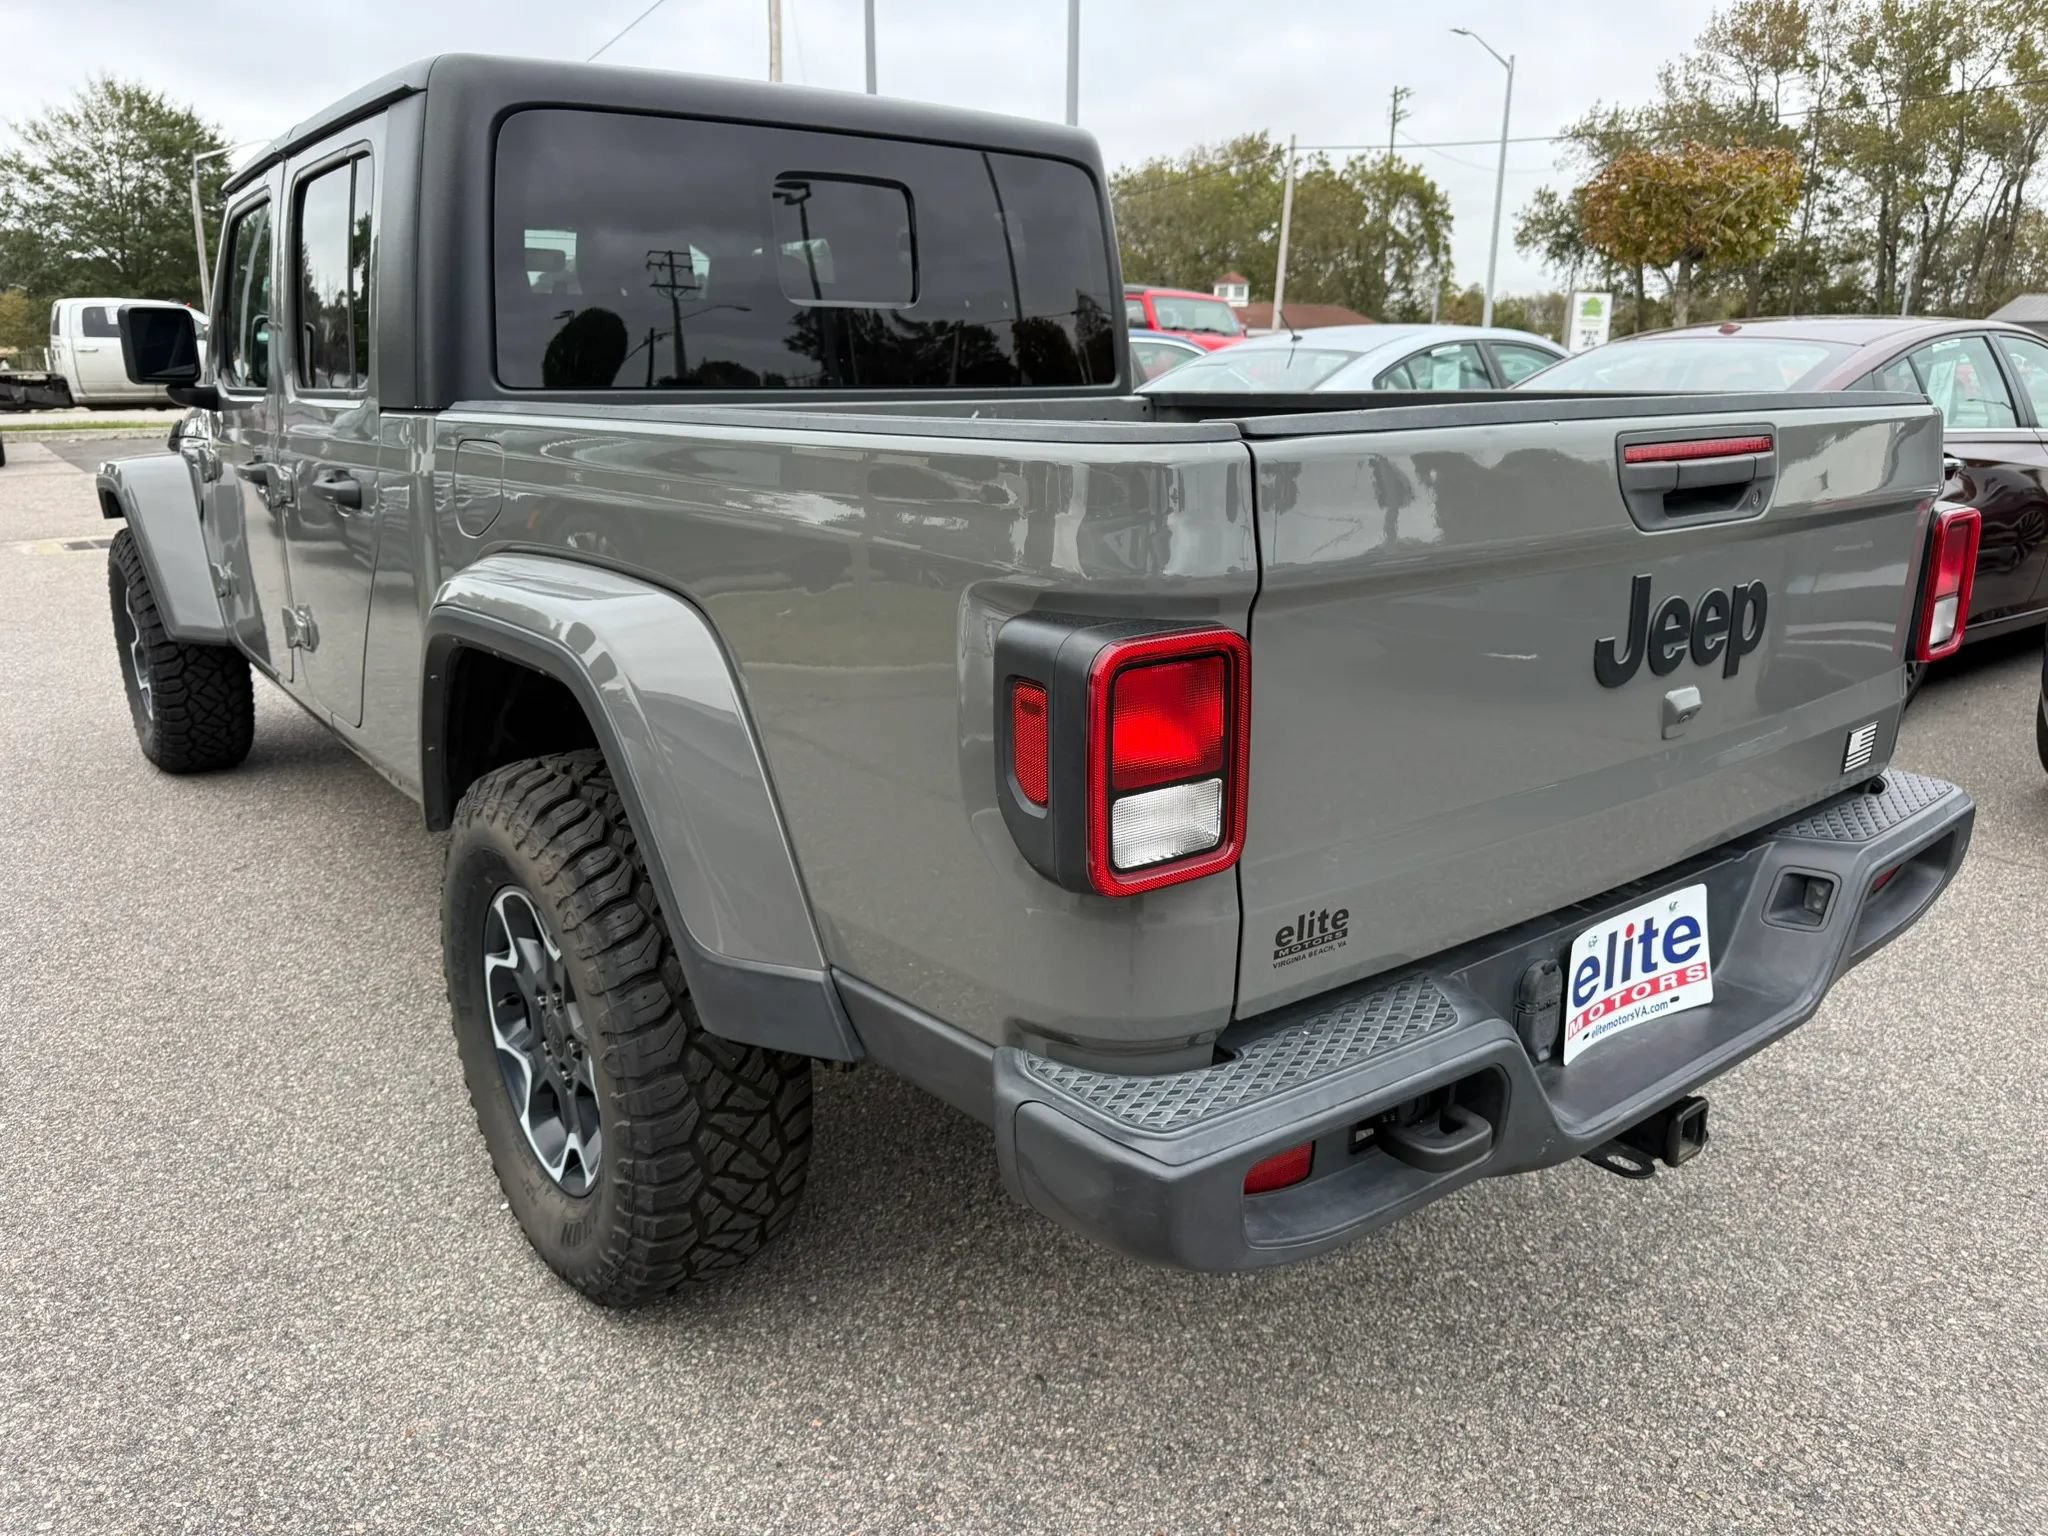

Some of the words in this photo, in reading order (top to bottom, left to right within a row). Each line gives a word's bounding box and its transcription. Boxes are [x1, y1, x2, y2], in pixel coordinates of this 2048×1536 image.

[1594, 573, 1768, 688] Jeep
[1275, 908, 1350, 948] elite
[1278, 930, 1344, 958] MOTORS
[1272, 953, 1307, 969] VIRGINIA
[1308, 944, 1336, 959] BEACH,
[1337, 940, 1347, 949] VA
[1572, 915, 1702, 1008] elite
[1568, 964, 1707, 1039] MOTORS
[1591, 1001, 1669, 1039] elitemotorsVA.com
